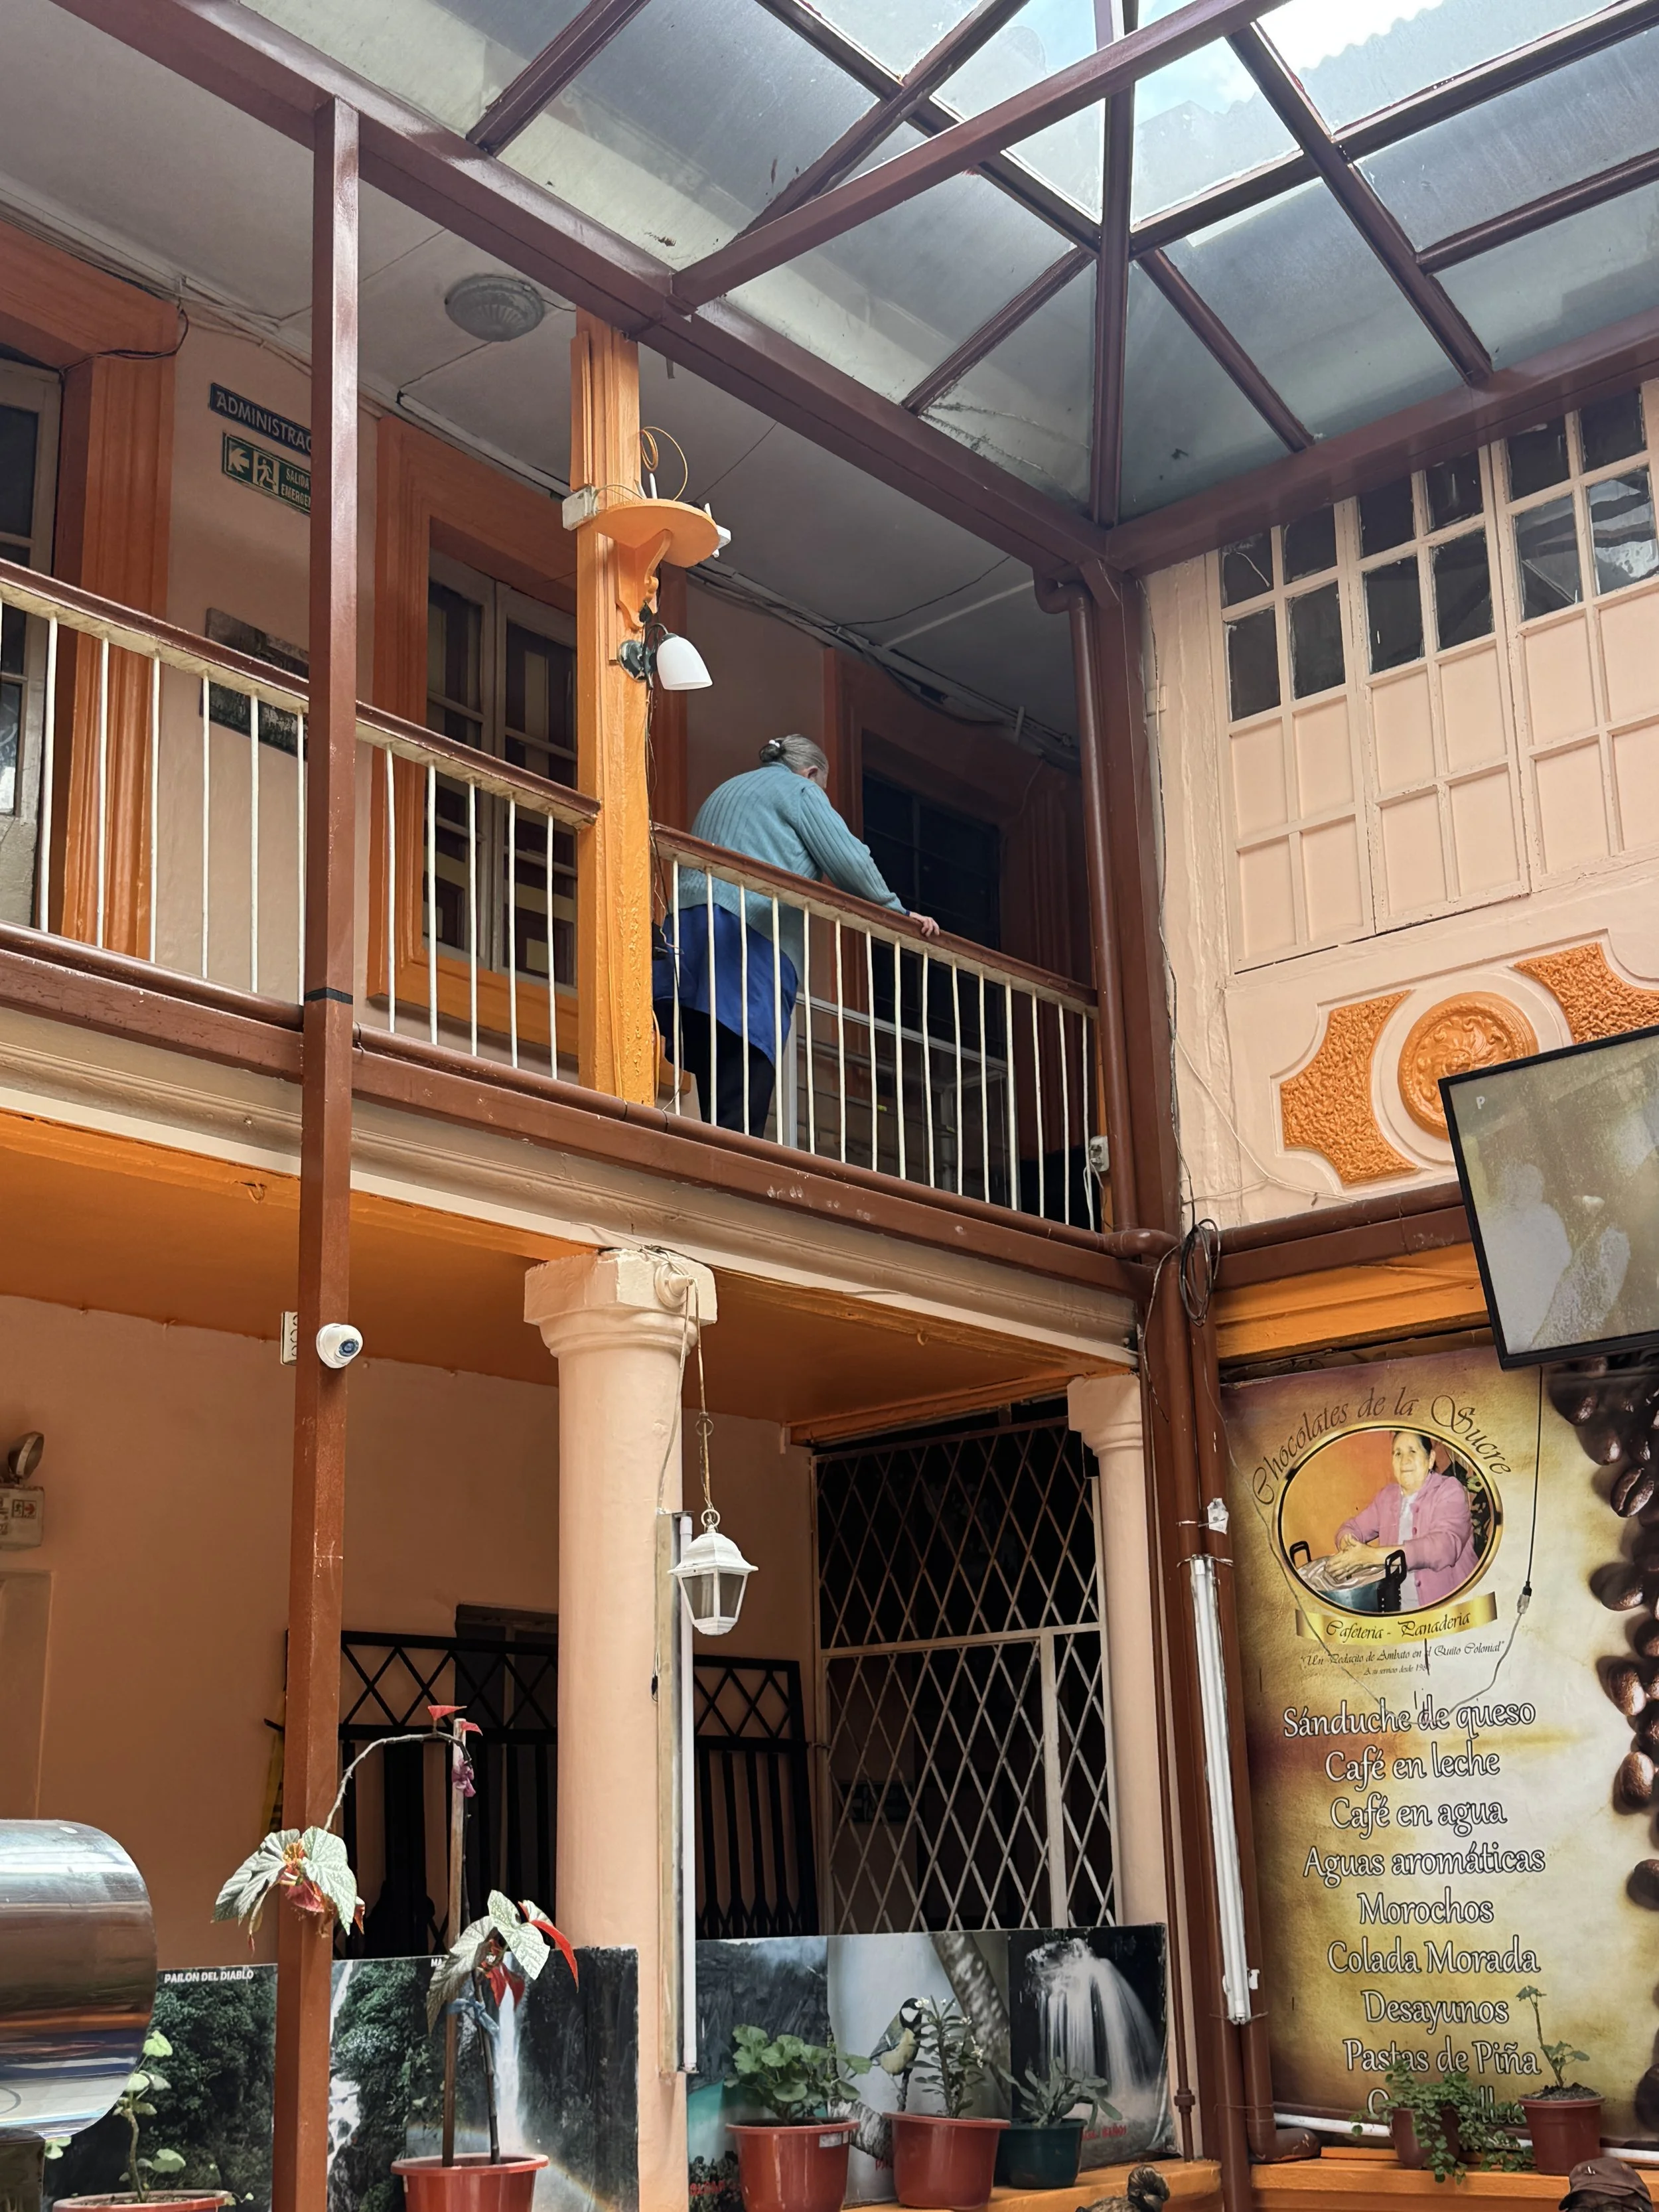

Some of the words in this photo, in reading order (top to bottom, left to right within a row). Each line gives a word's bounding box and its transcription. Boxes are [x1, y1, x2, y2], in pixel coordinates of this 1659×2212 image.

[286, 468, 309, 490] SALIDA
[1476, 1096, 1486, 1110] P
[1252, 1403, 1348, 1506] Chocolates
[1357, 1388, 1385, 1418] de
[1394, 1387, 1419, 1417] la
[1431, 1395, 1512, 1475] Sucre
[1326, 1620, 1382, 1643] Cafeteria
[1398, 1612, 1471, 1637] Panaderia
[1366, 1651, 1375, 1662] de
[1377, 1649, 1410, 1661] Ambato
[1412, 1650, 1422, 1659] en
[1434, 1645, 1461, 1657] Quito
[1283, 1698, 1412, 1738] Sánduche
[1418, 1694, 1450, 1732] de
[1456, 1700, 1536, 1739] queso
[1325, 1745, 1386, 1793] Café
[1392, 1757, 1427, 1780] en
[1431, 1739, 1500, 1779] leche
[1330, 1792, 1391, 1840] Café
[1396, 1803, 1432, 1828] en
[1438, 1801, 1508, 1838] agua
[1303, 1845, 1385, 1889] Aguas
[1391, 1841, 1546, 1876] aromáticas
[1357, 1886, 1495, 1925] Morochos
[1327, 1935, 1421, 1974] Colada
[1424, 1934, 1542, 1974] Morada
[201, 1971, 219, 1982] DEL
[220, 1970, 254, 1980] DIABLO
[1361, 1989, 1510, 2035] Desayunos
[1342, 2037, 1429, 2074] Pastas
[1436, 2035, 1469, 2074] de
[1472, 2039, 1543, 2076] Piña
